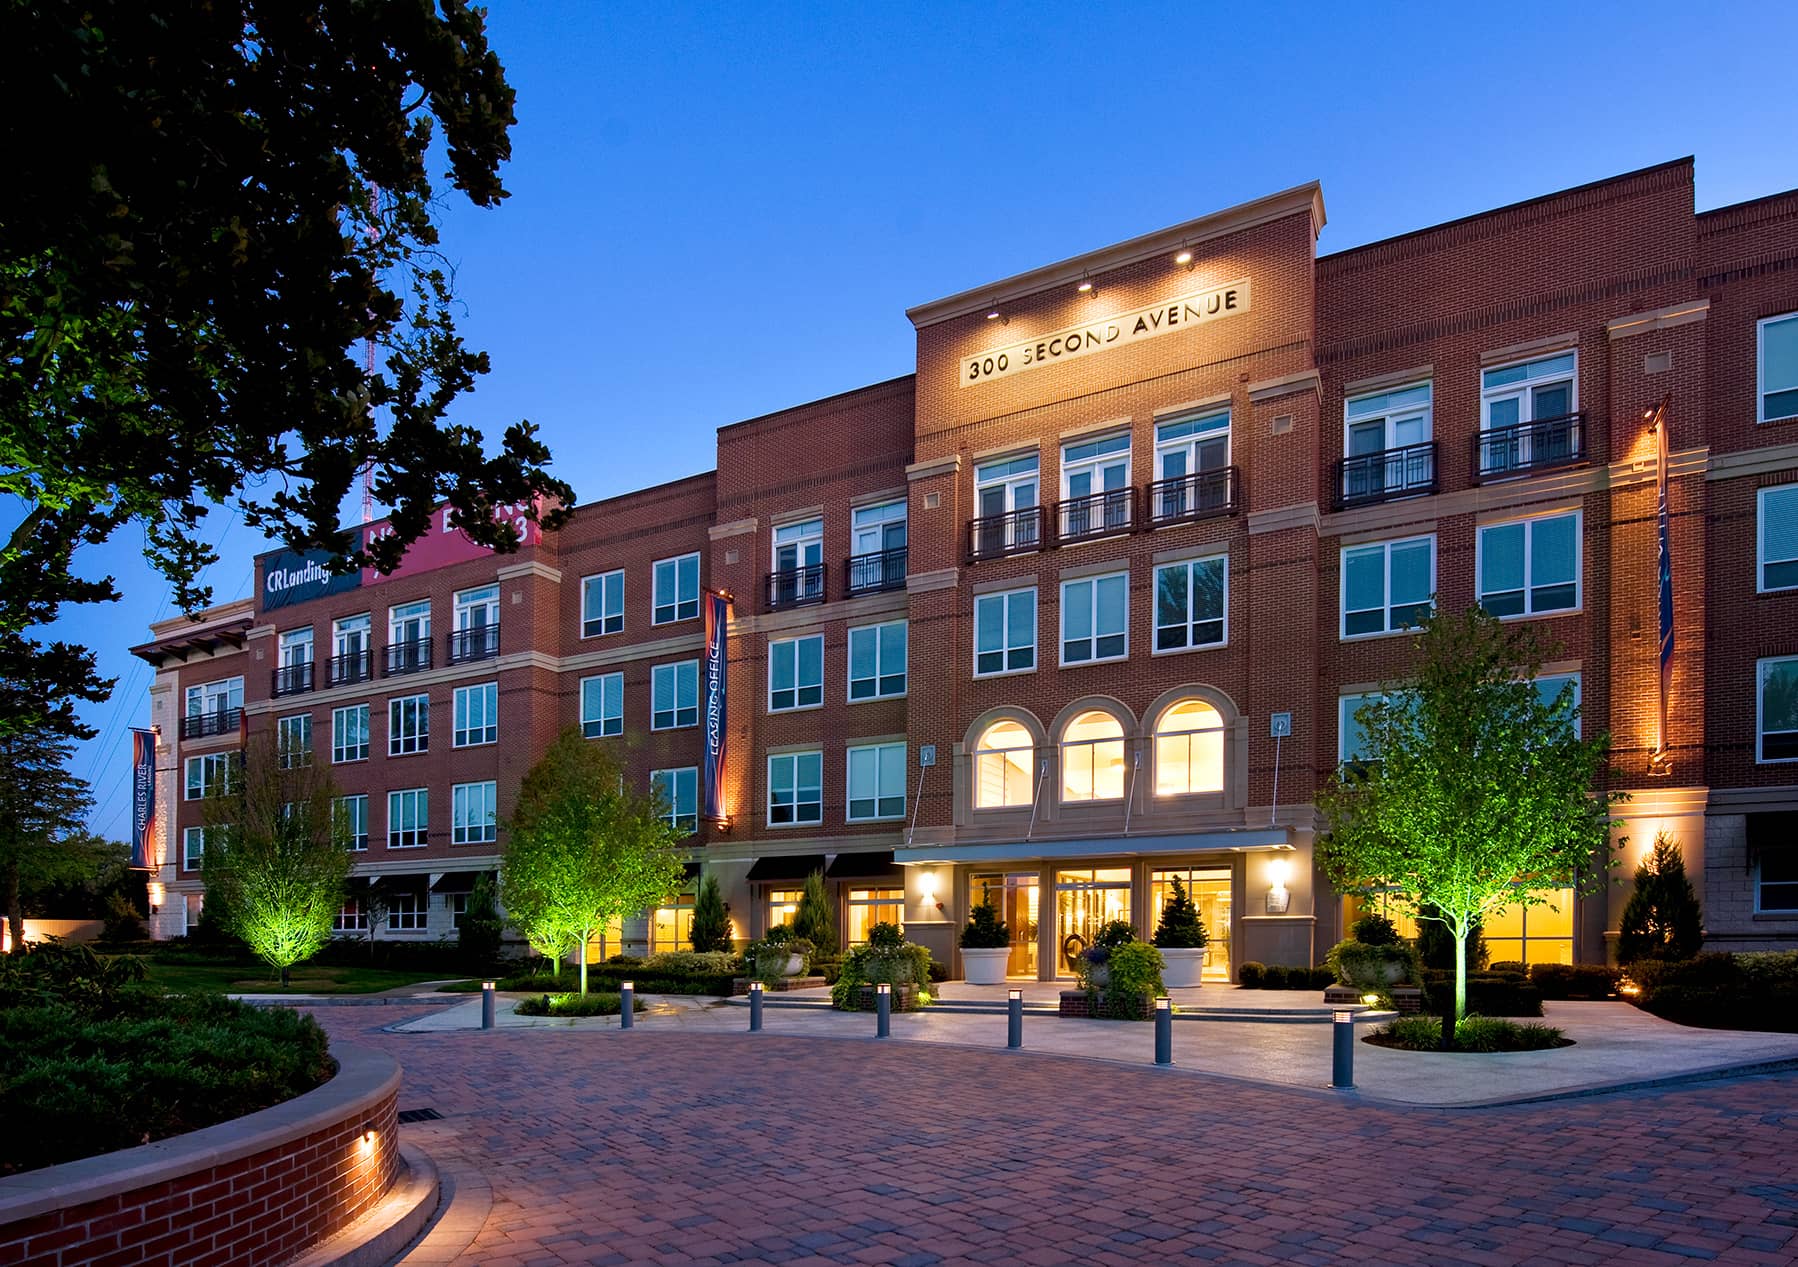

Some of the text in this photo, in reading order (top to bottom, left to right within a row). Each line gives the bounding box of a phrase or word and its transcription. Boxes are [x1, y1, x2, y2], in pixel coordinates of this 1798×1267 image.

[969, 290, 1237, 379] 300 SECOND AVENUE
[266, 558, 334, 593] CRLanding
[709, 640, 720, 756] LEASING OFFICE
[137, 763, 147, 831] CHARLES RIVER
